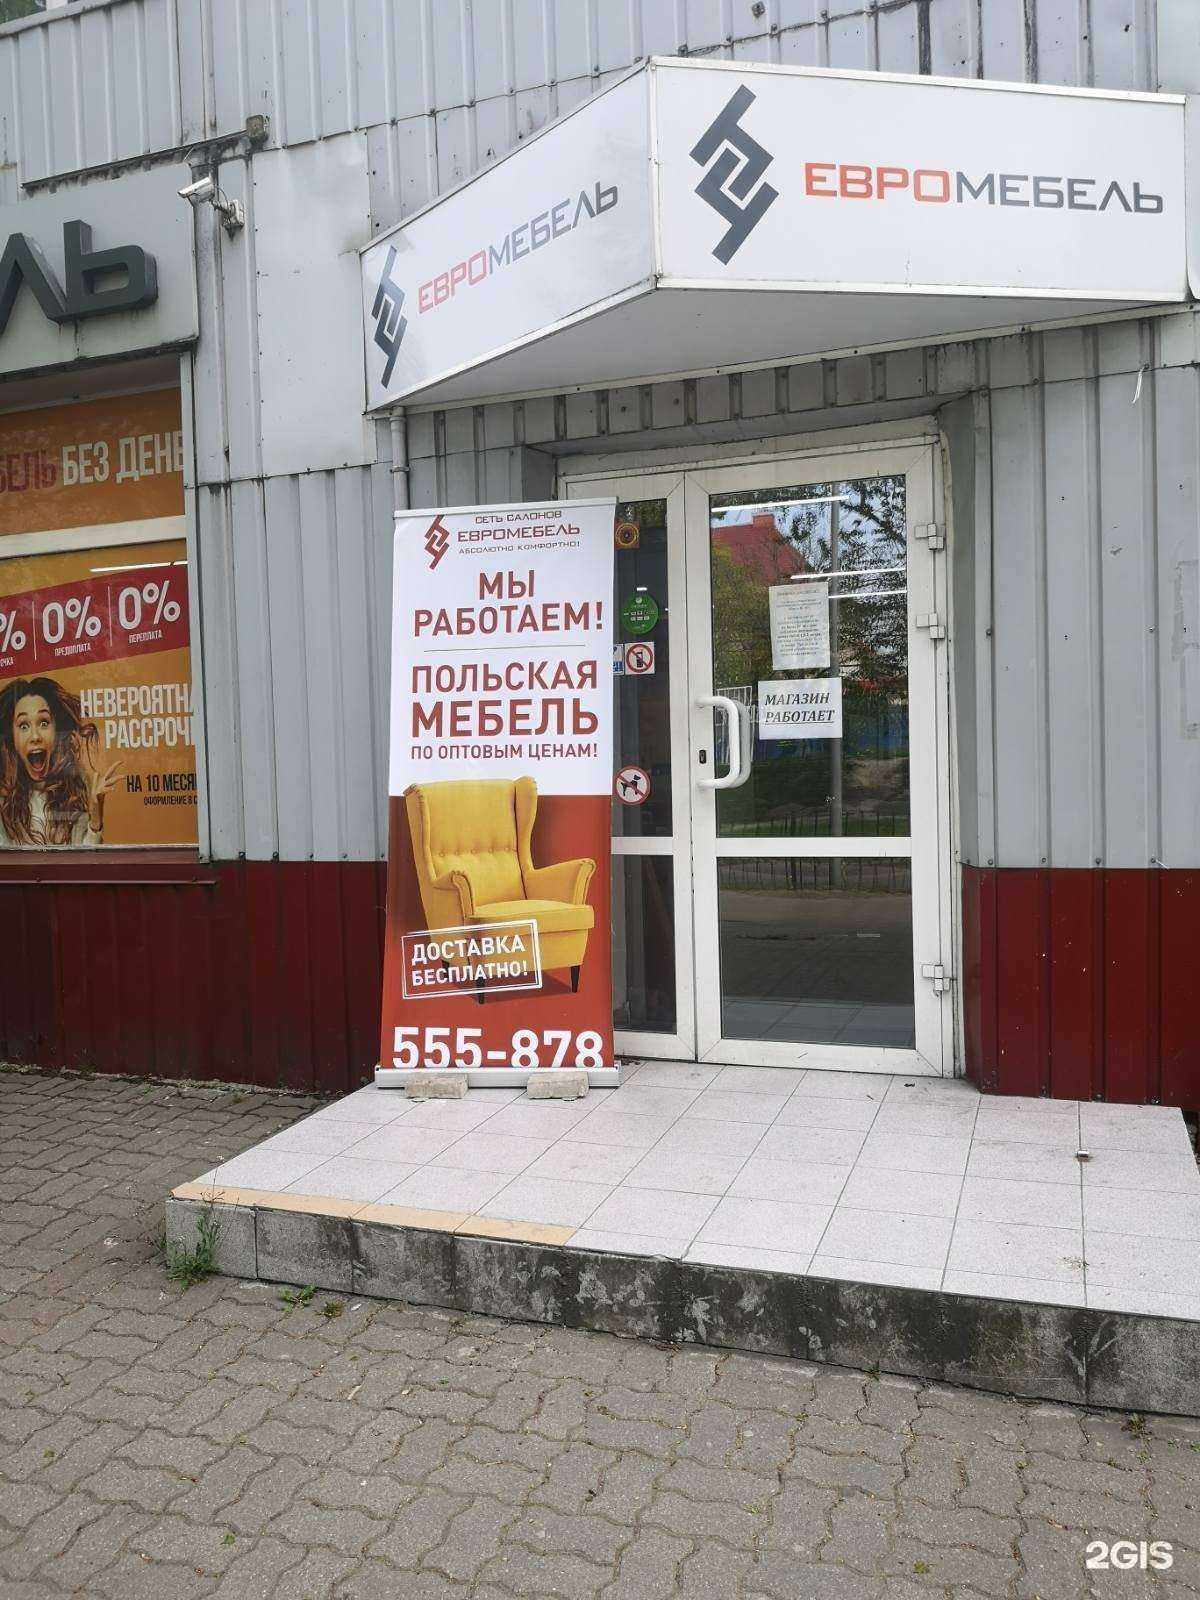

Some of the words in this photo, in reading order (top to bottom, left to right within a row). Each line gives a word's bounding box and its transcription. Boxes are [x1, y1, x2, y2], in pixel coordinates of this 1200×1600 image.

[803, 162, 1164, 214] ЕВРОМЕБЕЛЬ
[419, 181, 618, 314] ЕВРОМЕБЕЛЬ
[62, 440, 110, 486] БЕЗ
[457, 523, 580, 542] ЕВРОМЕБЕЛЬ
[475, 515, 504, 525] СЕТЬ
[506, 509, 562, 522] САЛОНОВ
[458, 545, 514, 555] АБСОЛЮТНО
[517, 541, 580, 552] КОМФОРТНО!
[479, 569, 535, 600] МЫ
[42, 595, 101, 644] 0%
[118, 580, 181, 630] 0%
[413, 600, 603, 637] РАБОТАЕМ!
[411, 660, 598, 693] ПОЛЬСКАЯ
[79, 682, 196, 718] НЕВЕРОЯТН
[764, 692, 831, 706] МАГАЗИН
[104, 715, 196, 749] РАССРОЧ
[411, 698, 599, 738] МЕБЕЛЬ
[765, 709, 836, 724] РАБОТАЕТ
[411, 745, 433, 760] ПО
[438, 745, 523, 760] ОПТОВЫМ
[528, 743, 598, 761] ЦЕНАМ!
[126, 774, 143, 793] НА
[146, 773, 160, 793] 10
[162, 772, 197, 792] МЕСЯ
[411, 934, 526, 966] ДОСТАВКА
[411, 960, 528, 987] БЕСПЛАТНО!
[392, 1026, 604, 1069] 555-878
